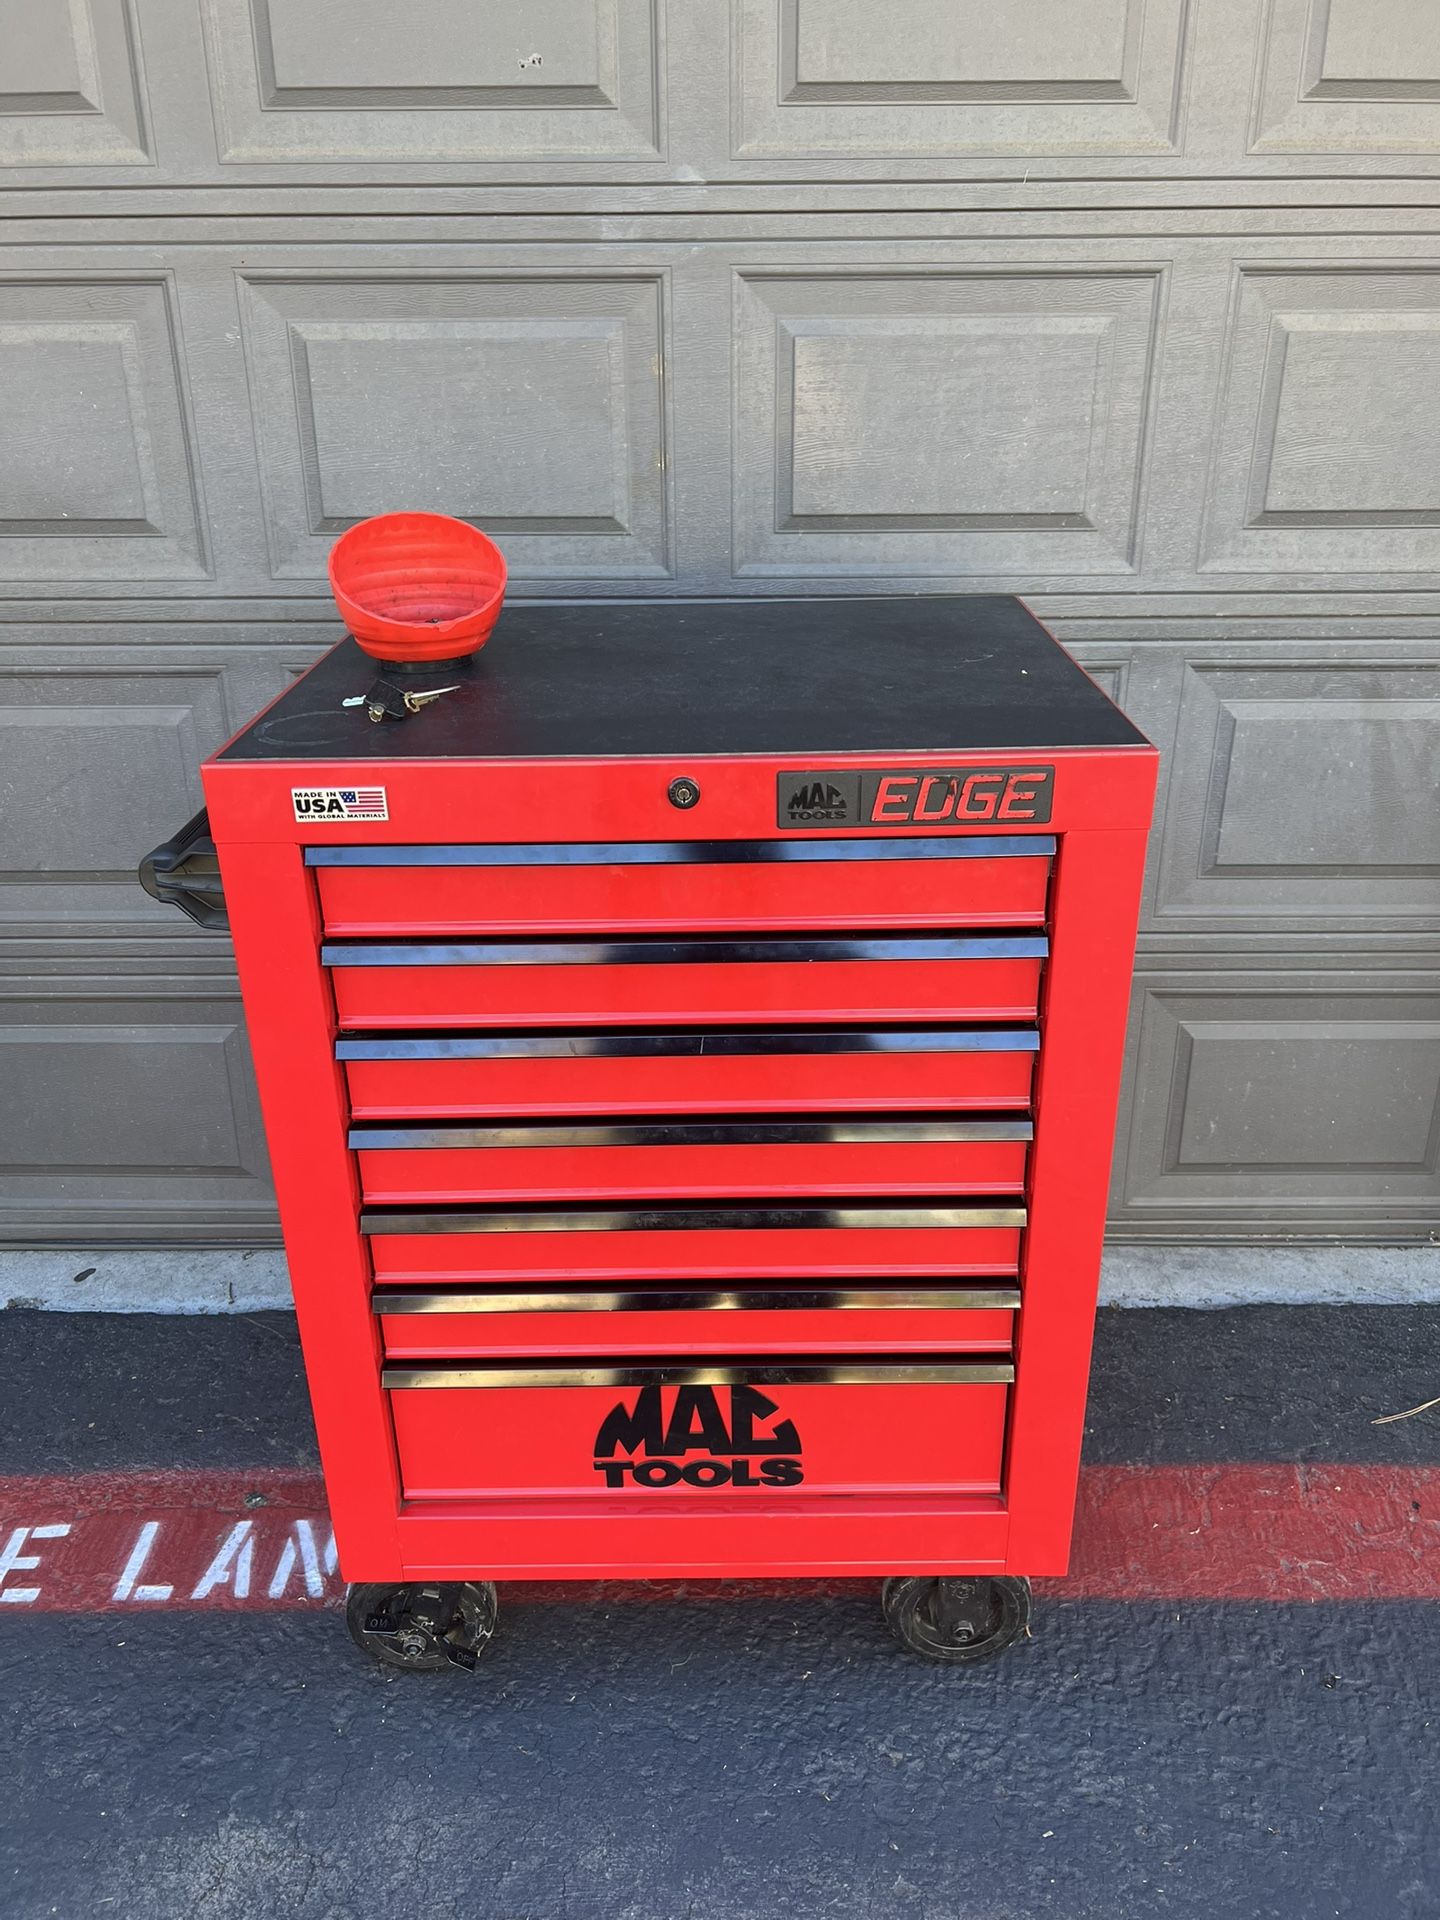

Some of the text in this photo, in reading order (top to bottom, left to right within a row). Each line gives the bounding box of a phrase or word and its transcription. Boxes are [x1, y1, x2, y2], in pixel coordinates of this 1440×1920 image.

[295, 798, 344, 813] USA
[787, 782, 847, 809] MAC
[870, 773, 1048, 822] EDGE
[787, 810, 847, 820] TOOLS
[593, 1385, 802, 1458] MAC
[593, 1458, 804, 1488] TOOLS
